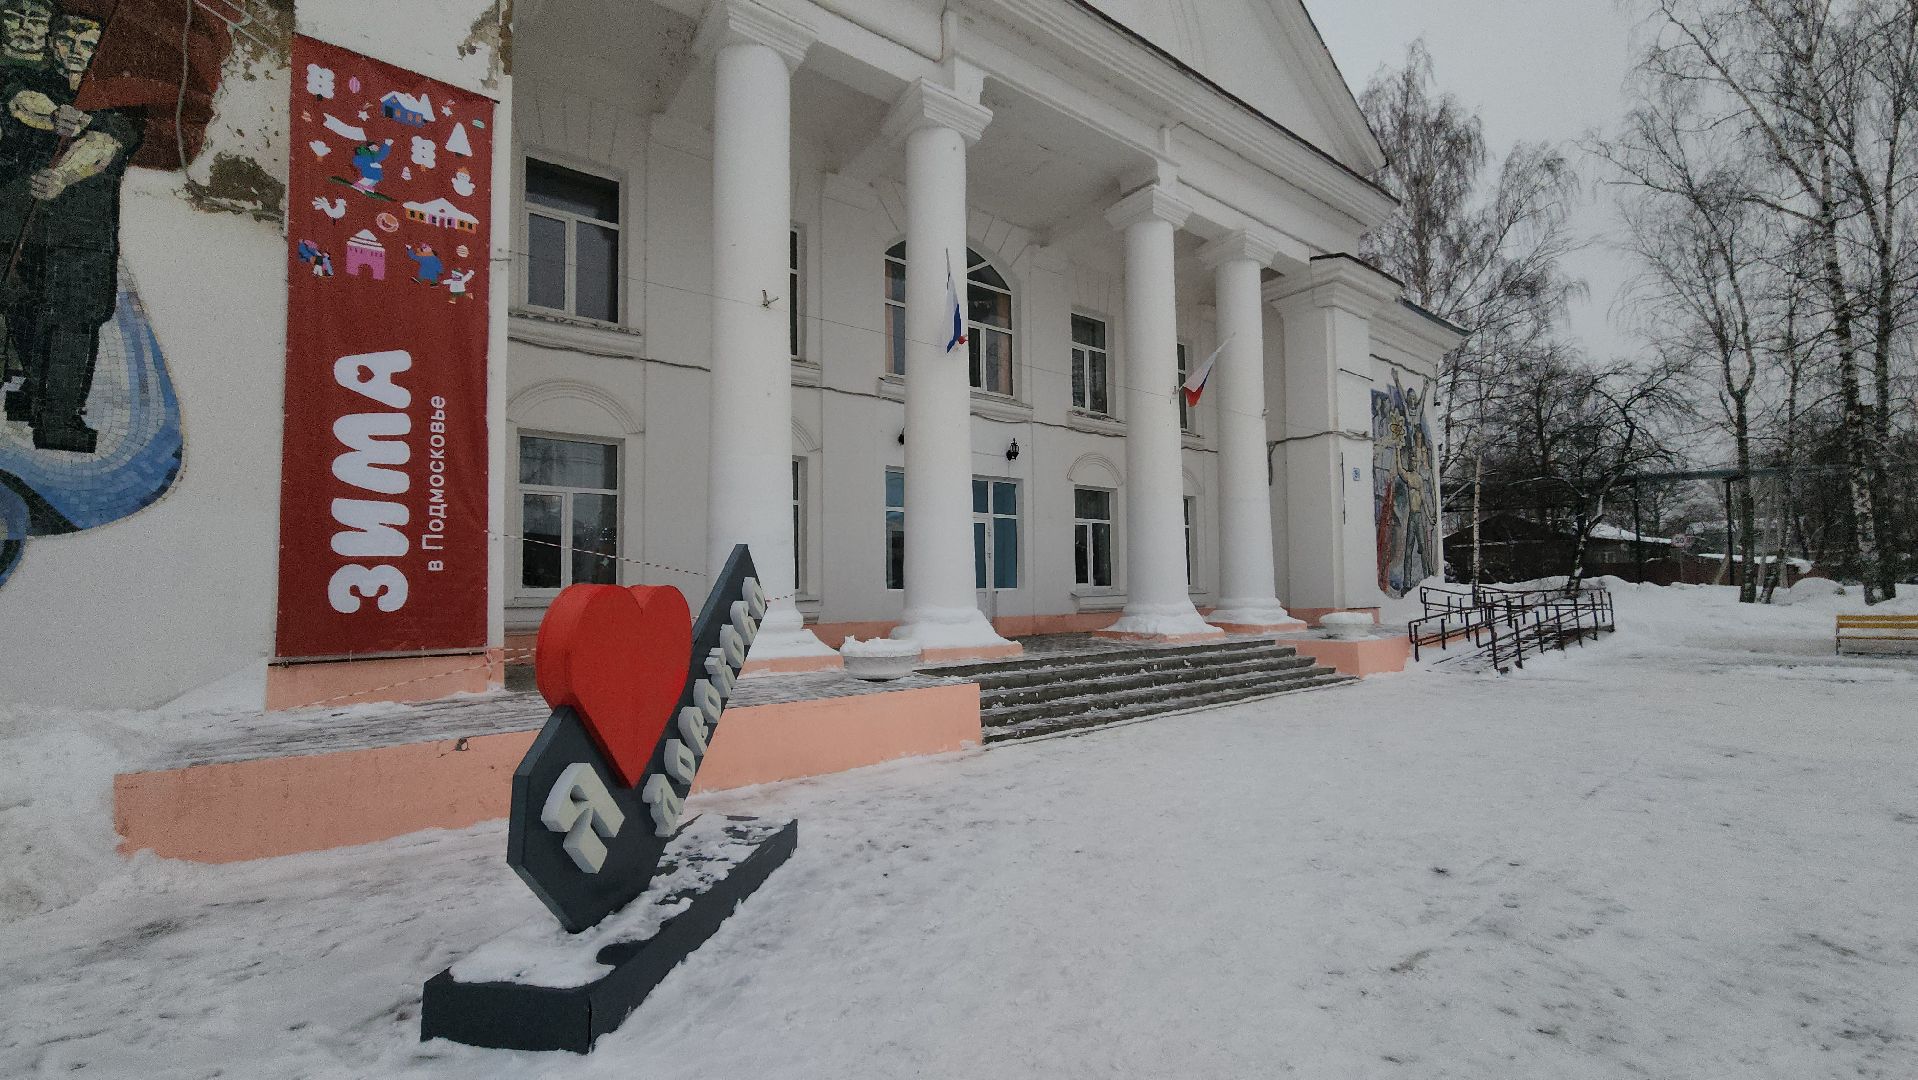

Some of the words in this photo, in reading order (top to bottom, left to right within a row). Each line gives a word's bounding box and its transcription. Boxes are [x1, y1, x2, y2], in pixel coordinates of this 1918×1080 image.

[328, 350, 412, 614] ЗИМА
[421, 395, 448, 551] Подмосковье
[428, 559, 444, 572] в
[541, 763, 625, 874] Я
[642, 577, 767, 837] ДОРОХОВО
